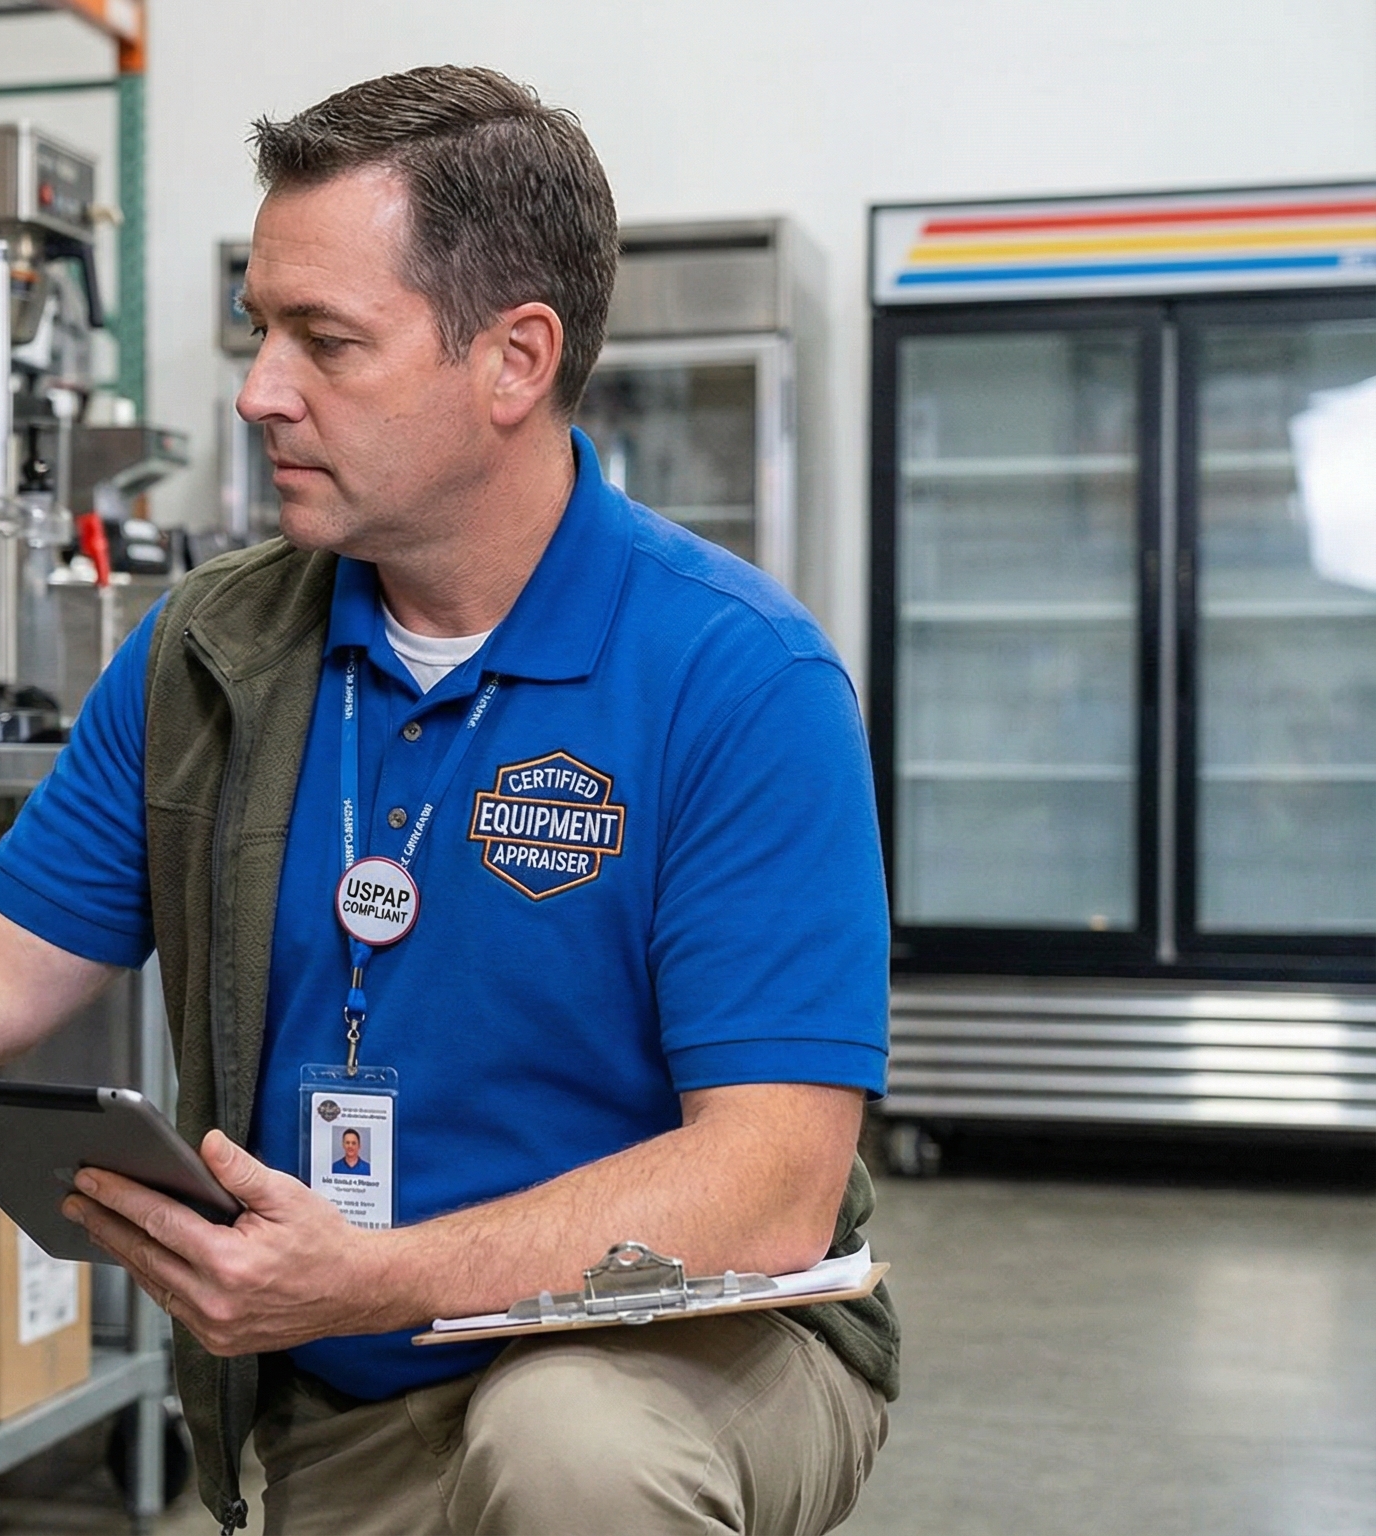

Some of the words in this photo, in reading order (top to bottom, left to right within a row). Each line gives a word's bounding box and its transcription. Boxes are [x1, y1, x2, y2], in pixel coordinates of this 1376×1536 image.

[508, 768, 599, 799] CERTIFIED
[479, 802, 618, 844] EQUIPMENT
[492, 844, 590, 874] APPRAISER
[346, 878, 410, 909] USPAP
[342, 900, 409, 924] COMPLIANT
